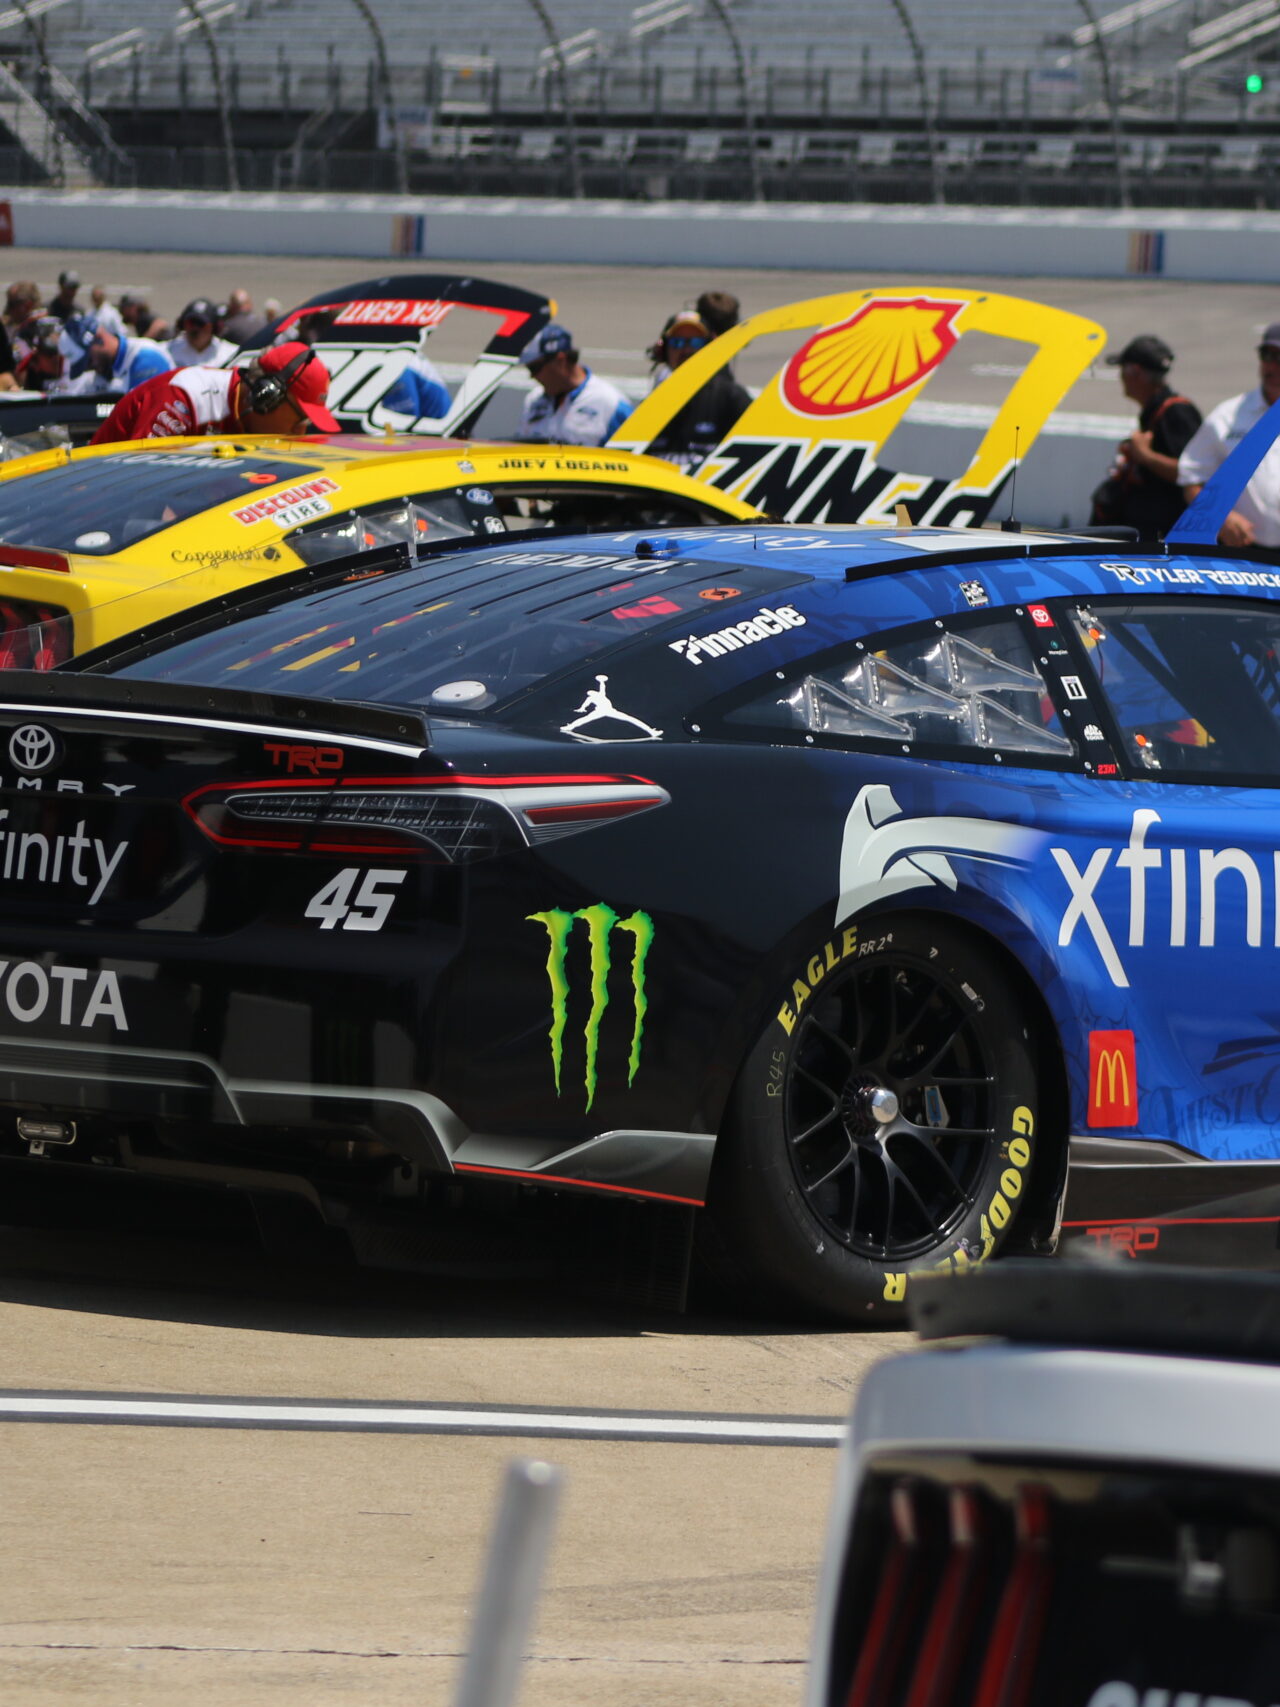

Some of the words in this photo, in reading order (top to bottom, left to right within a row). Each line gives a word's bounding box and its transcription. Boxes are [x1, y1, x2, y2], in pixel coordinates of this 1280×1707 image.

[498, 458, 547, 469] JOEY
[555, 460, 630, 472] LOGANO
[231, 477, 341, 525] DISCOUNT
[278, 500, 326, 524] TIRE
[1135, 567, 1204, 584] TYLER
[668, 604, 807, 666] Pinnacle
[263, 743, 345, 775] TRD
[304, 867, 408, 932] 45
[0, 959, 130, 1032] OTA
[777, 925, 859, 1038] EAGLE
